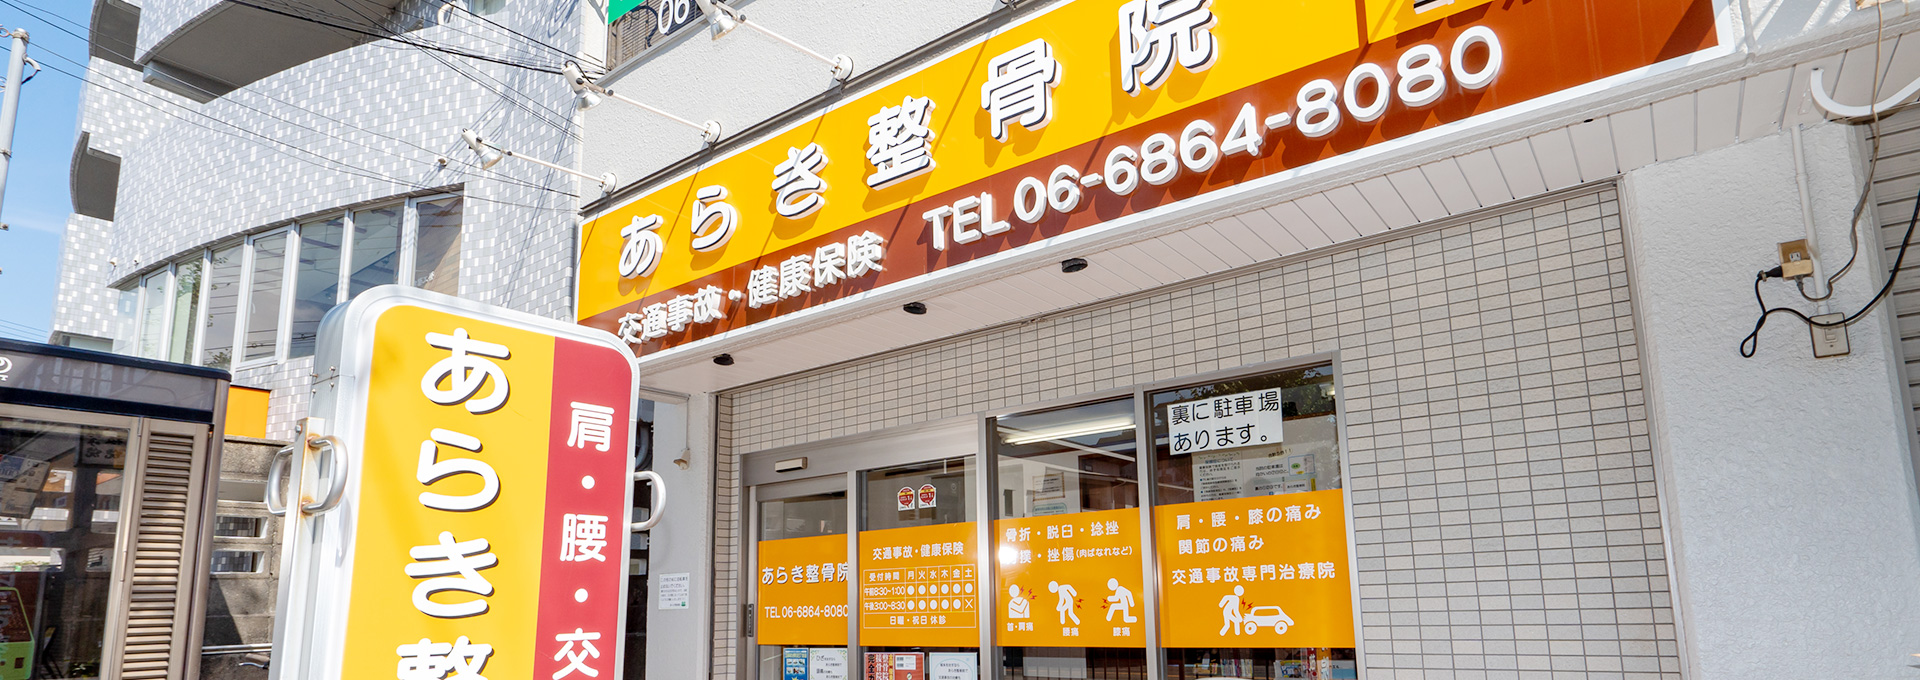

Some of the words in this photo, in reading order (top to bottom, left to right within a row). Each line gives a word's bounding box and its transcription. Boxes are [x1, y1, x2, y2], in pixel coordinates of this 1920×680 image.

[1013, 25, 1502, 224] 06-6864-8080
[617, 0, 1219, 280] あらき整骨院
[617, 230, 884, 346] 交通事故・健康保険
[1171, 390, 1279, 426] 裏に駐車場
[1173, 423, 1268, 452] あります。
[1176, 504, 1322, 531] 肩・腰・膝の痛み
[1005, 520, 1119, 542] 骨折・脱臼・捻挫
[872, 541, 964, 561] 交通事故・健康保険
[1004, 545, 1133, 565] 撲・挫傷（肉ばなれなど）
[1178, 535, 1265, 555] 関節の痛み
[761, 561, 848, 585] あらき整骨院
[869, 571, 900, 582] 受付時間
[907, 570, 915, 580] 月
[918, 570, 926, 580] 火
[929, 569, 937, 579] 水
[940, 569, 949, 579] 木
[952, 568, 961, 578] 金
[964, 568, 972, 578] 土
[1171, 561, 1336, 585] 交通事故専門治療院
[764, 606, 780, 618] TEL
[782, 604, 848, 618] 06-6864-8080
